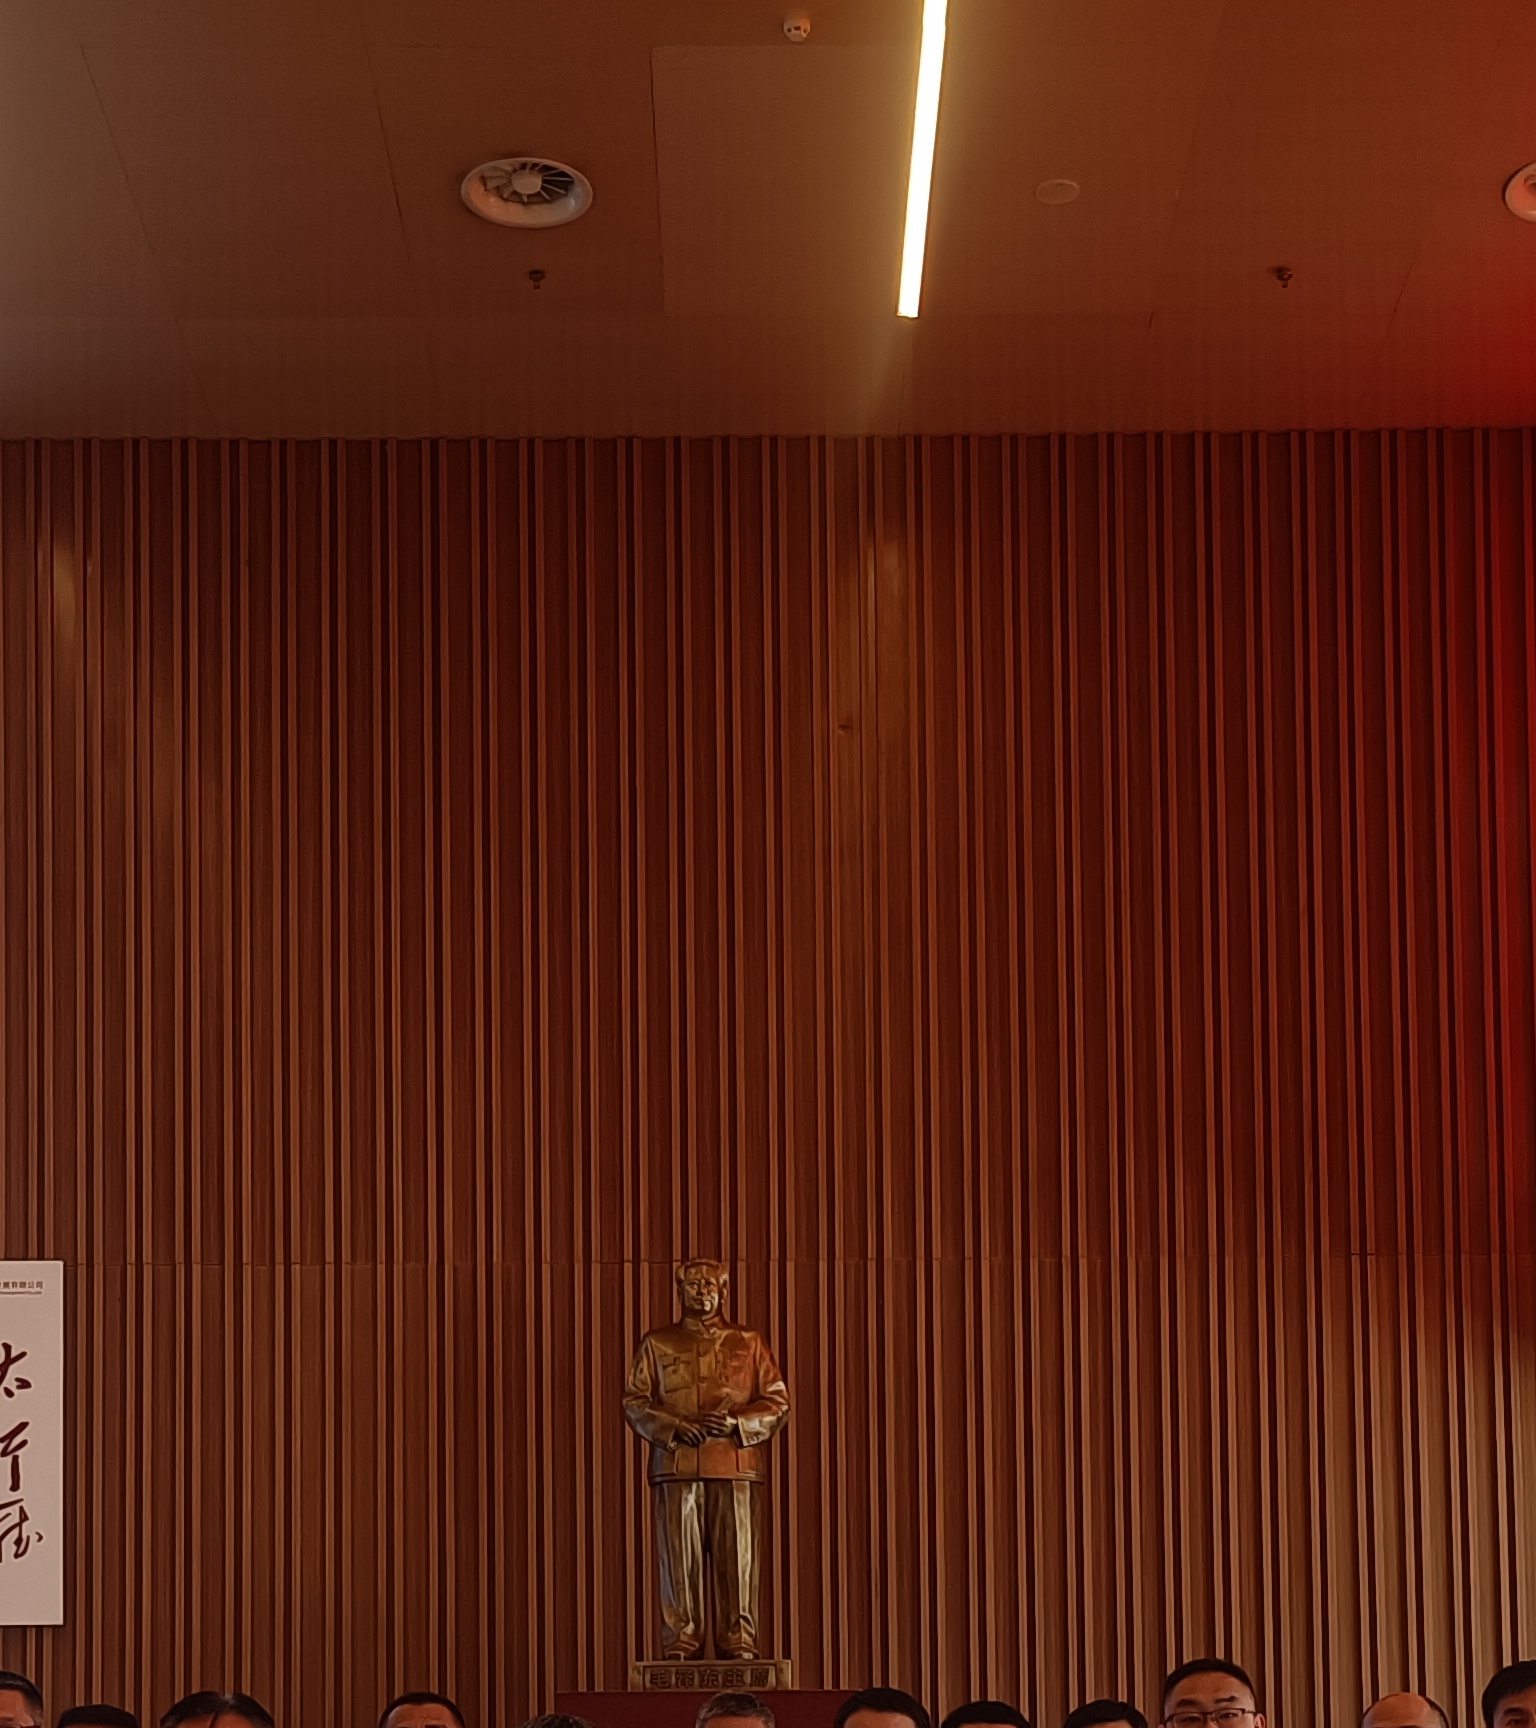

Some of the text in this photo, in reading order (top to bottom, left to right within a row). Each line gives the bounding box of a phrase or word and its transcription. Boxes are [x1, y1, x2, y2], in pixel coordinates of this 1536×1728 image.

[650, 1667, 770, 1689] 毛泽东主席
